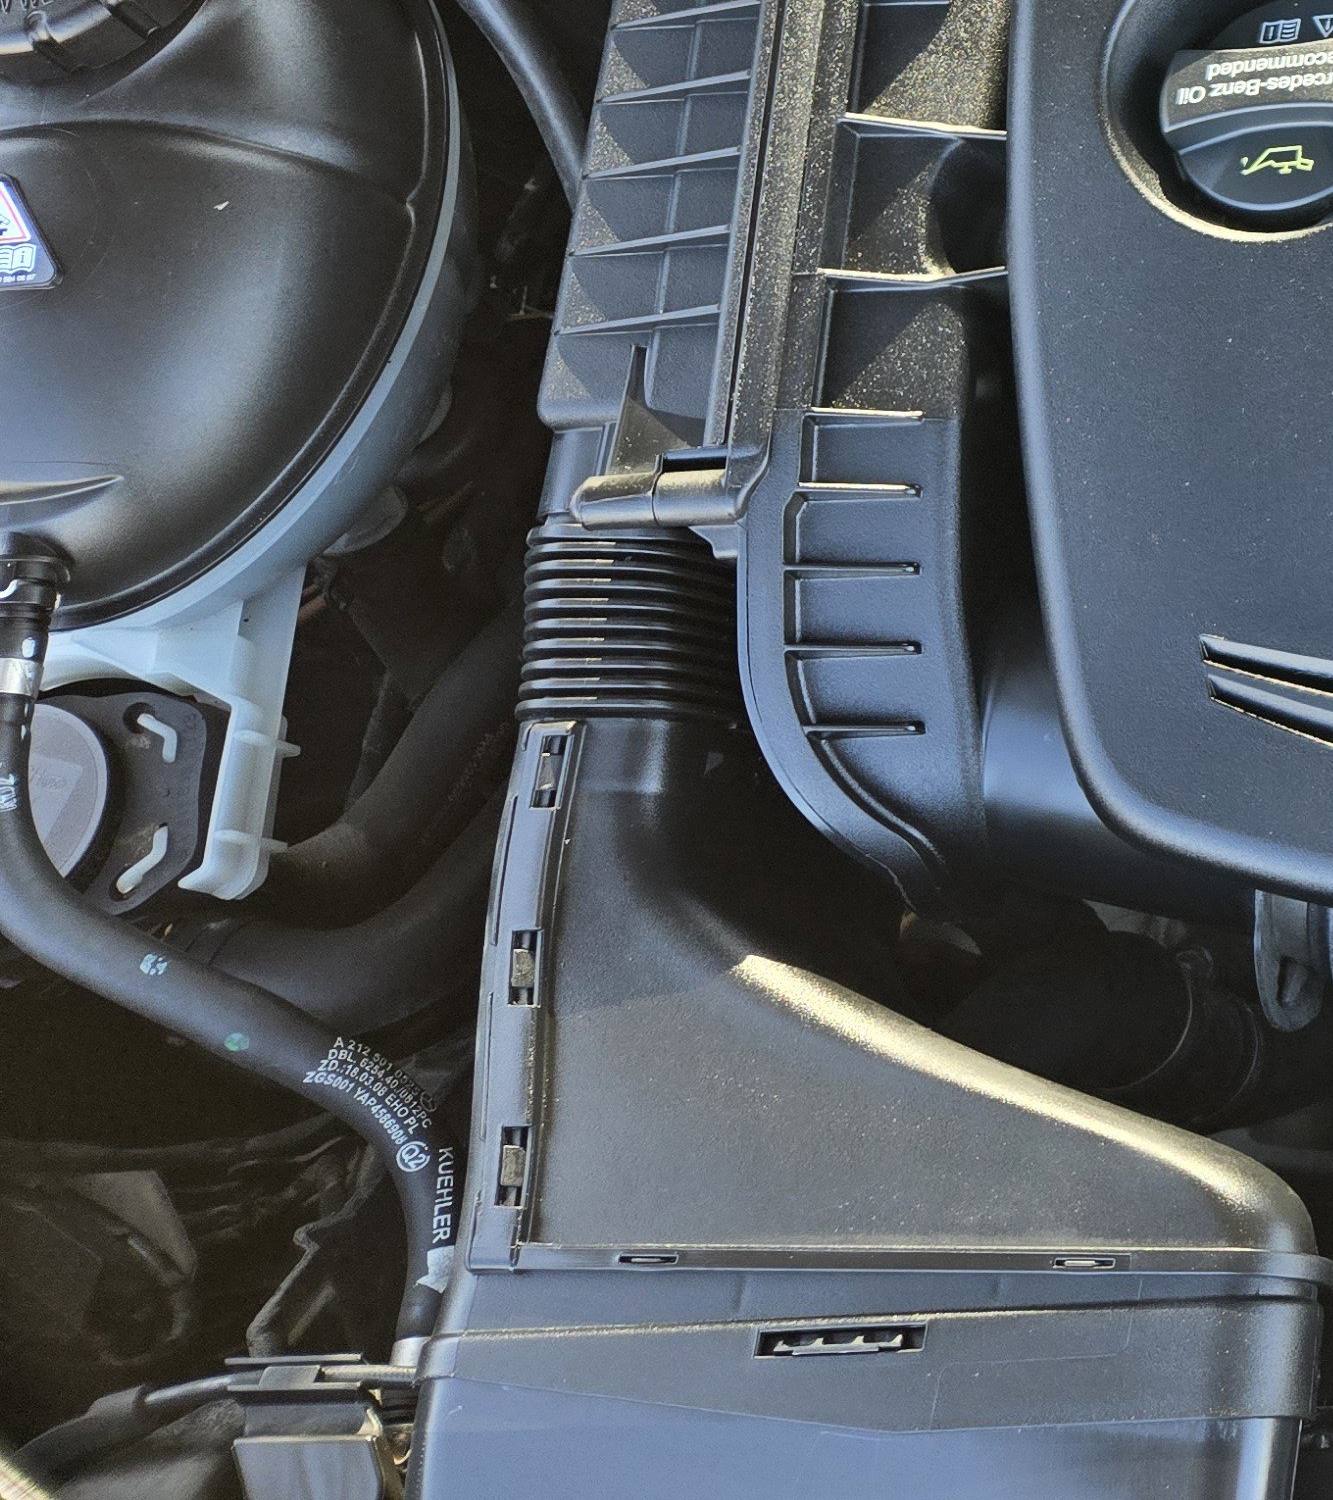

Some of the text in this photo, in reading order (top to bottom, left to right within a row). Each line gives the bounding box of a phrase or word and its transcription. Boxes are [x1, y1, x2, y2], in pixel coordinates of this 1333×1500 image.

[1174, 86, 1207, 106] Oil
[333, 1037, 344, 1048] A
[347, 1039, 371, 1056] 212
[303, 1071, 355, 1093] ZGS001
[384, 1093, 409, 1118] EHO
[403, 1116, 420, 1135] PL
[432, 1146, 454, 1244] KUEHLER
